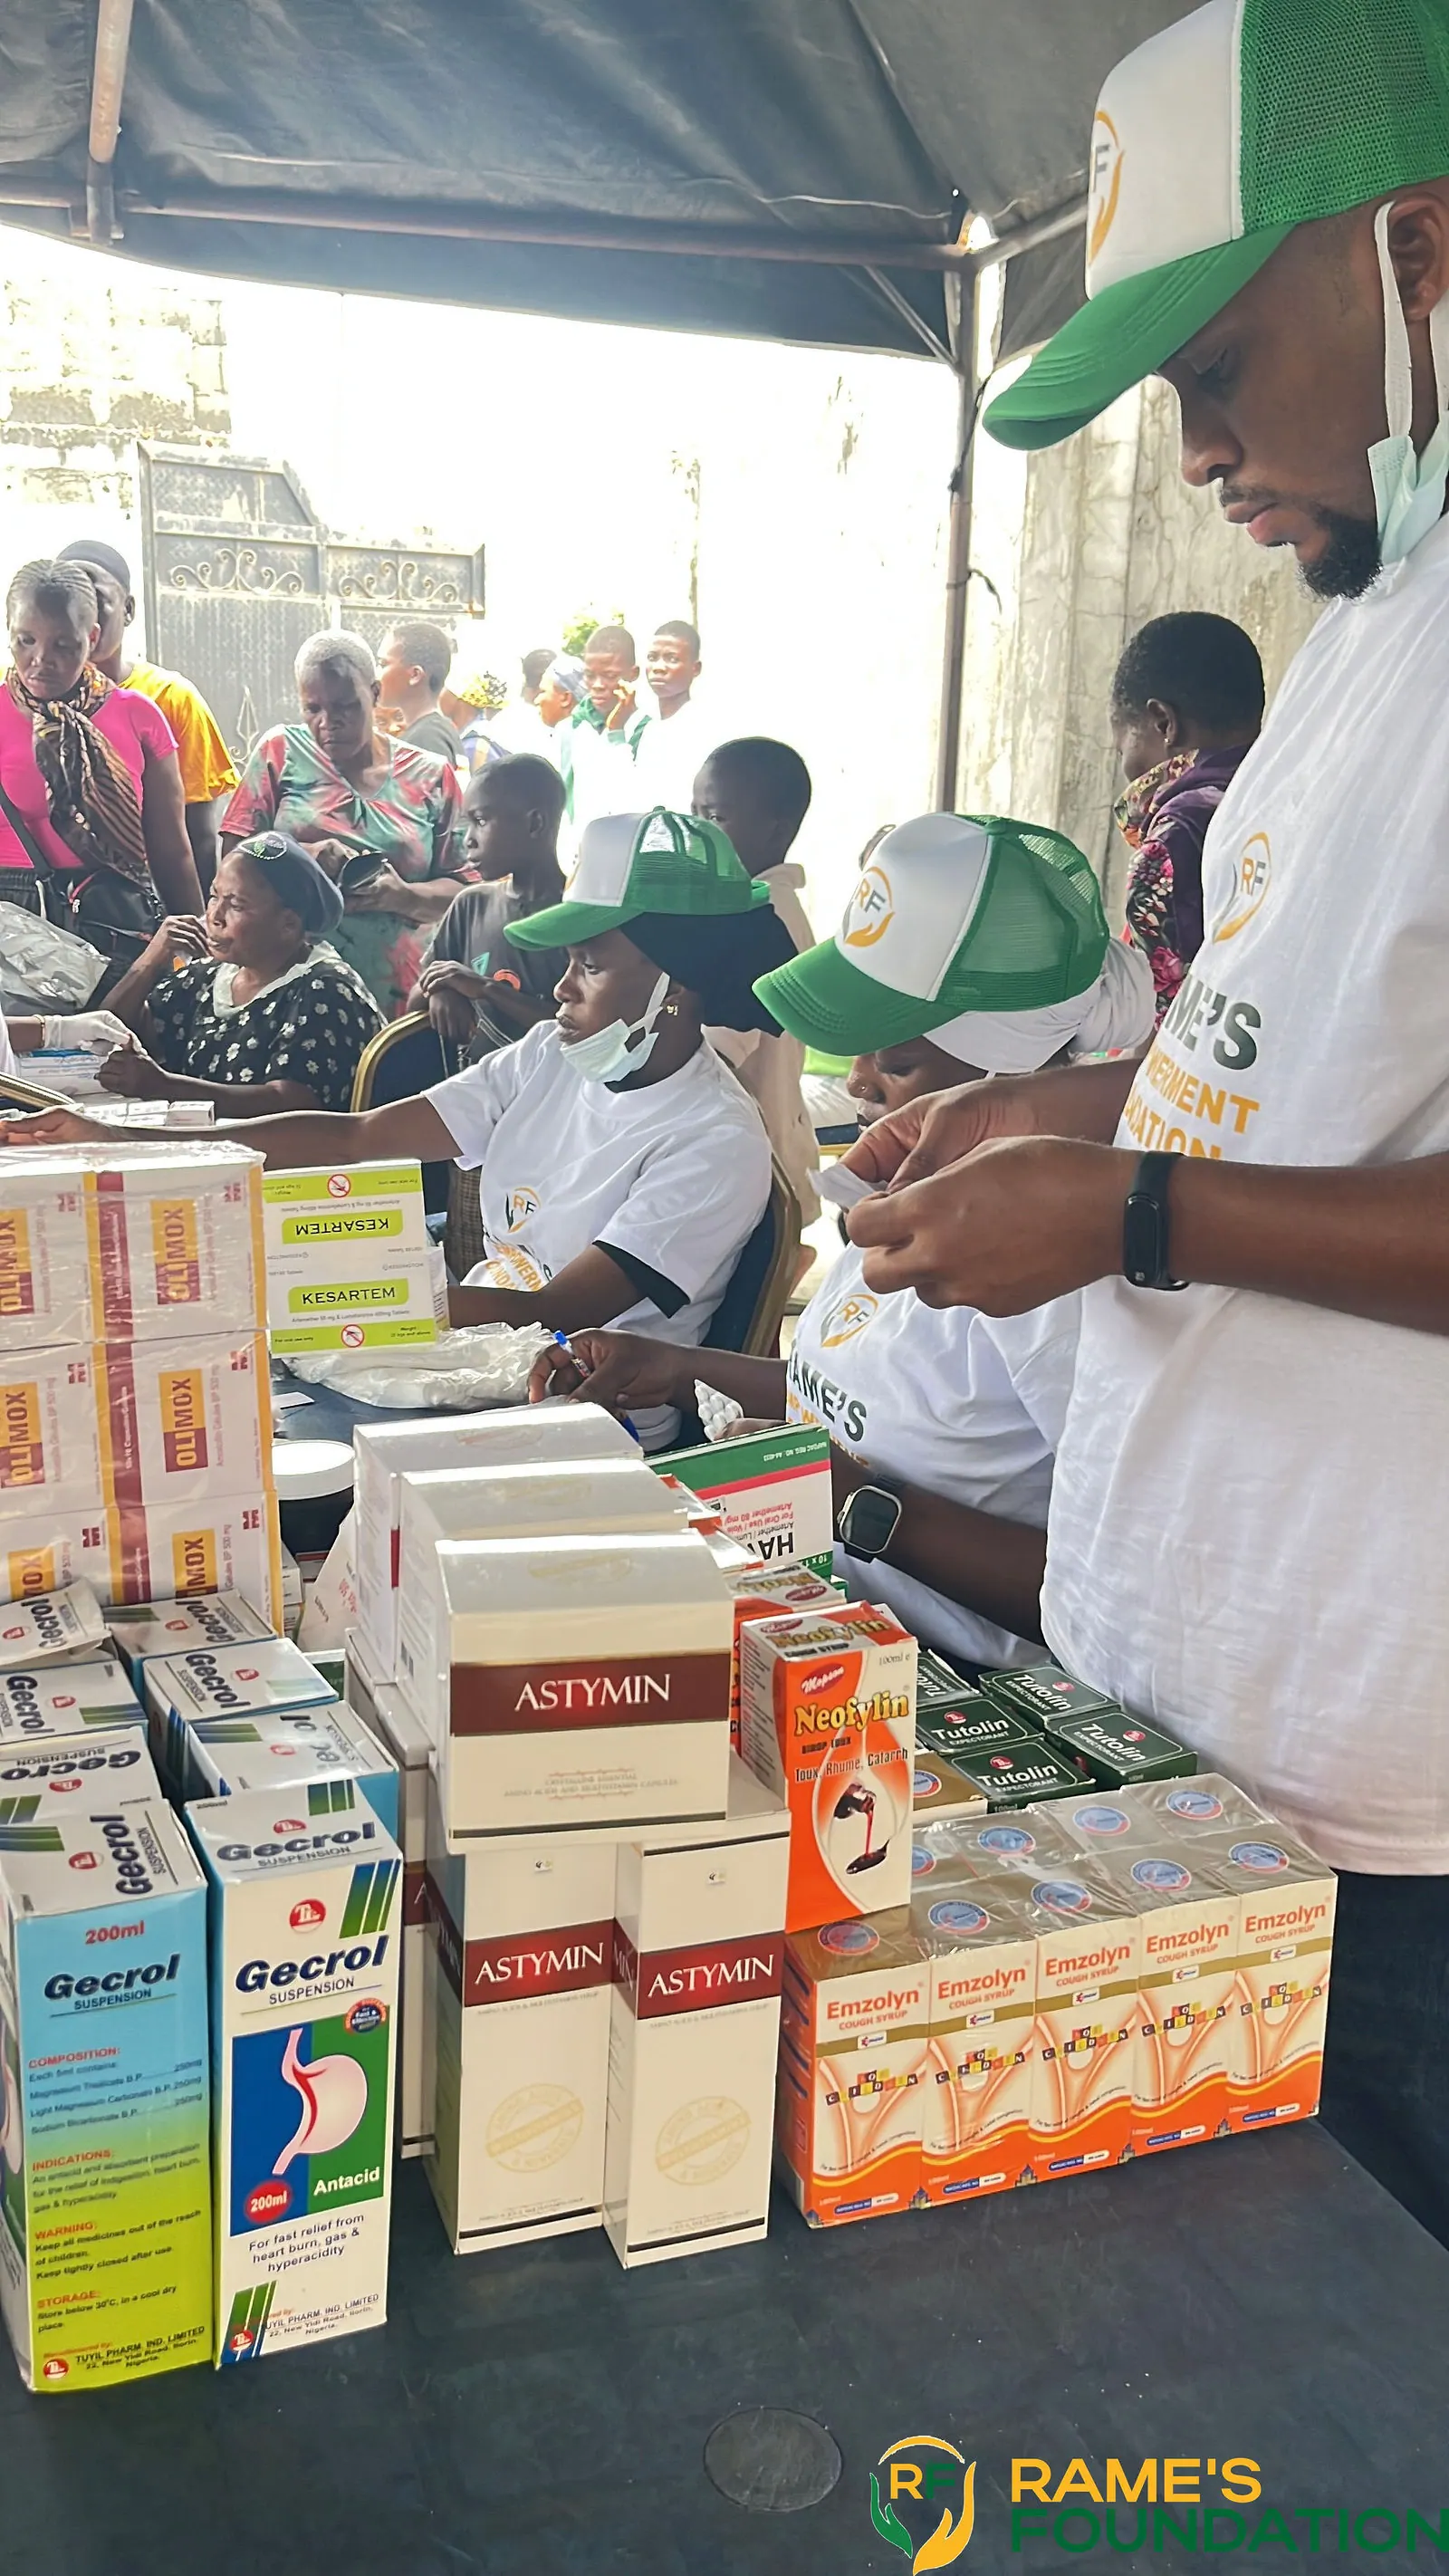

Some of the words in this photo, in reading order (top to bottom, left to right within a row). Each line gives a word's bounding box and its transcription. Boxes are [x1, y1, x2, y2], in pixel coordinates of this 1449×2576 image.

[1242, 857, 1266, 897] RF
[856, 879, 886, 913] RF
[513, 1195, 536, 1214] RF
[295, 1217, 389, 1235] KESARTEM
[164, 1207, 190, 1300] OLIMOX
[302, 1287, 395, 1305] KESARTEM
[841, 1301, 869, 1324] RF
[5, 1391, 34, 1482] OLIMOX
[172, 1378, 197, 1467] OLIMOX
[749, 1516, 763, 1528] Use
[758, 1522, 793, 1537] Artemether
[769, 1513, 783, 1524] Oral
[784, 1511, 793, 1521] For
[818, 1554, 828, 1563] 10
[21, 1599, 67, 1648] Gecrol
[176, 1600, 235, 1642] Gecrol
[767, 1618, 890, 1648] Neofylin
[186, 1654, 251, 1708] Gecrol
[514, 1674, 670, 1712] ASTYMIN
[801, 1665, 845, 1693] Mopson
[1013, 1674, 1071, 1710] Tutolin
[6, 1676, 55, 1734] Gecrol
[1005, 1680, 1051, 1711] EXPECTORANT
[794, 1691, 909, 1735] Neofylin
[931, 1719, 1009, 1740] Tutolin
[949, 1731, 1009, 1745] EXPECTORANT
[1081, 1724, 1146, 1761] Tutolin
[17, 1748, 105, 1765] SUSPENSION
[868, 1747, 909, 1766] Catarrh
[1073, 1731, 1125, 1761] EXPECTORANT
[1, 1750, 140, 1780] Gecro
[976, 1764, 1059, 1786] Tutolin
[996, 1777, 1059, 1793] EXPECTORANT
[91, 1815, 152, 1894] Gecrol
[137, 1827, 166, 1875] SUSPENSION
[217, 1821, 376, 1860] Gecrol
[258, 1846, 351, 1867] SUSPENSION
[85, 1920, 144, 1945] 200ml
[1244, 1904, 1326, 1933] Emzolyn
[1147, 1923, 1230, 1954] Emzolyn
[1255, 1931, 1286, 1944] COUGH
[1288, 1924, 1315, 1937] SYRUP
[235, 1935, 389, 1994] Gecrol
[475, 1942, 604, 1985] ASTYMIN
[1046, 1945, 1130, 1976] Emzolyn
[1156, 1951, 1187, 1964] COUGH
[1190, 1943, 1219, 1956] SYRUP
[43, 1954, 180, 2000] Gecrol
[269, 1976, 354, 2004] SUSPENSION
[648, 1955, 774, 1998] ASTYMIN
[937, 1968, 1025, 1999] Emzolyn
[1056, 1975, 1088, 1987] COUGH
[1090, 1966, 1119, 1978] SYRUP
[74, 1988, 151, 2011] SUSPENSION
[827, 1990, 918, 2020] Emzolyn
[949, 1997, 982, 2010] COUGH
[984, 1989, 1014, 2002] SYRUP
[839, 2017, 873, 2030] COUGH
[876, 2010, 908, 2023] SYRUP
[28, 2047, 120, 2069] COMPOSITION:
[29, 2071, 53, 2083] Each
[30, 2085, 81, 2100] Magnesium
[31, 2106, 53, 2118] Light
[54, 2099, 105, 2113] Magnesium
[83, 2164, 101, 2173] and
[313, 2166, 380, 2196] Antacid
[48, 2186, 62, 2195] the
[64, 2180, 87, 2192] relief
[90, 2178, 99, 2187] of
[34, 2205, 50, 2214] gas
[250, 2188, 288, 2215] 200ml
[35, 2242, 61, 2252] Keep
[77, 2229, 126, 2244] medicines
[176, 2211, 201, 2223] reach
[249, 2239, 270, 2251] For
[273, 2231, 297, 2244] fast
[301, 2221, 332, 2236] relief
[336, 2215, 364, 2227] from
[254, 2247, 284, 2263] heart
[289, 2239, 321, 2254] burn,
[325, 2231, 347, 2245] gas
[351, 2227, 360, 2236] &
[36, 2269, 62, 2279] Keep
[64, 2263, 93, 2274] tightly
[97, 2256, 128, 2268] closed
[131, 2251, 152, 2261] after
[268, 2245, 345, 2272] hyperacidity
[38, 2311, 62, 2319] Store
[65, 2305, 93, 2314] below
[140, 2291, 160, 2300] cool
[162, 2284, 177, 2295] dry
[344, 2293, 379, 2309] LIMITED
[283, 2325, 302, 2333] New
[75, 2353, 102, 2364] TUYIL
[168, 2326, 205, 2344] LIMITED
[102, 2357, 121, 2367] New
